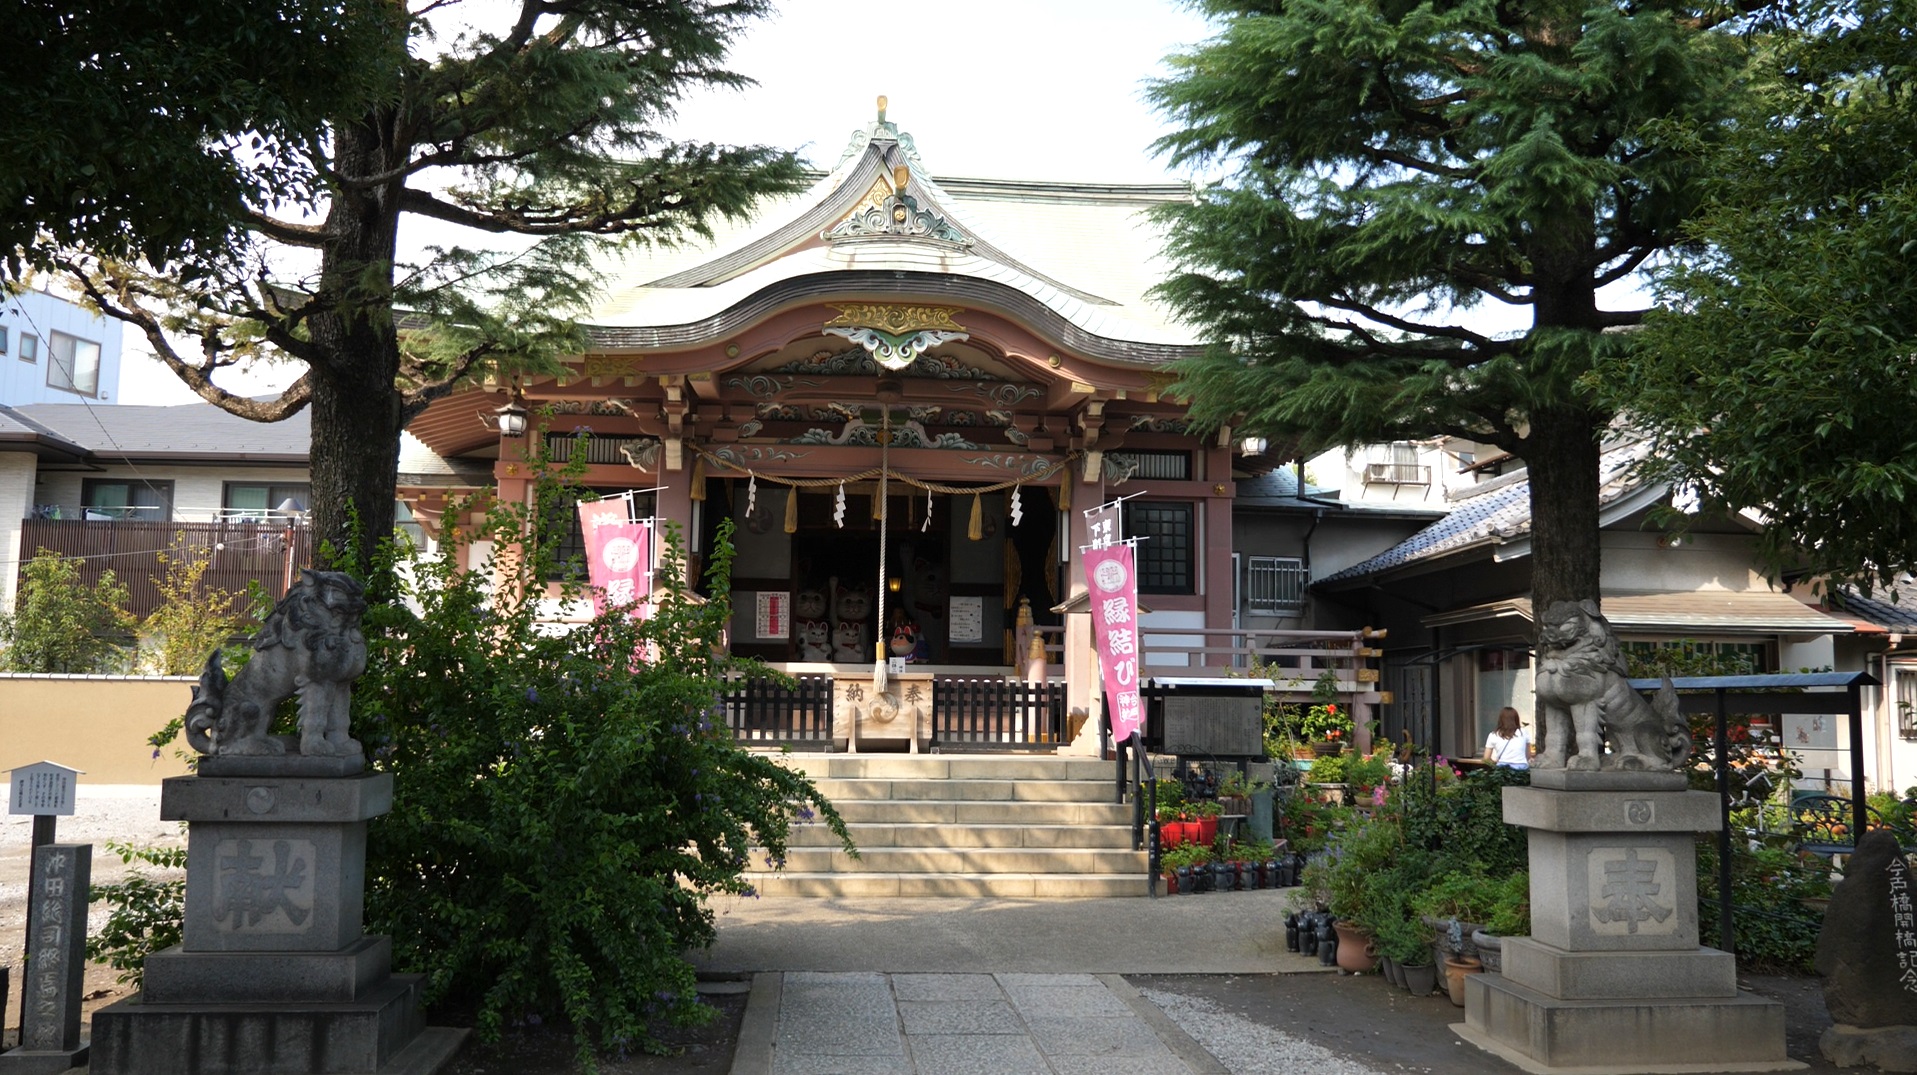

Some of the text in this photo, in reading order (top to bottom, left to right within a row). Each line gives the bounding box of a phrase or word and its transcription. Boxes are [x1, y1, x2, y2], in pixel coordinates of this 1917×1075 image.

[1103, 597, 1135, 686] 縁結び
[846, 682, 924, 705] 奉 納
[1590, 847, 1674, 935] 奉
[1885, 856, 1917, 992] 今戸橋開橋記念
